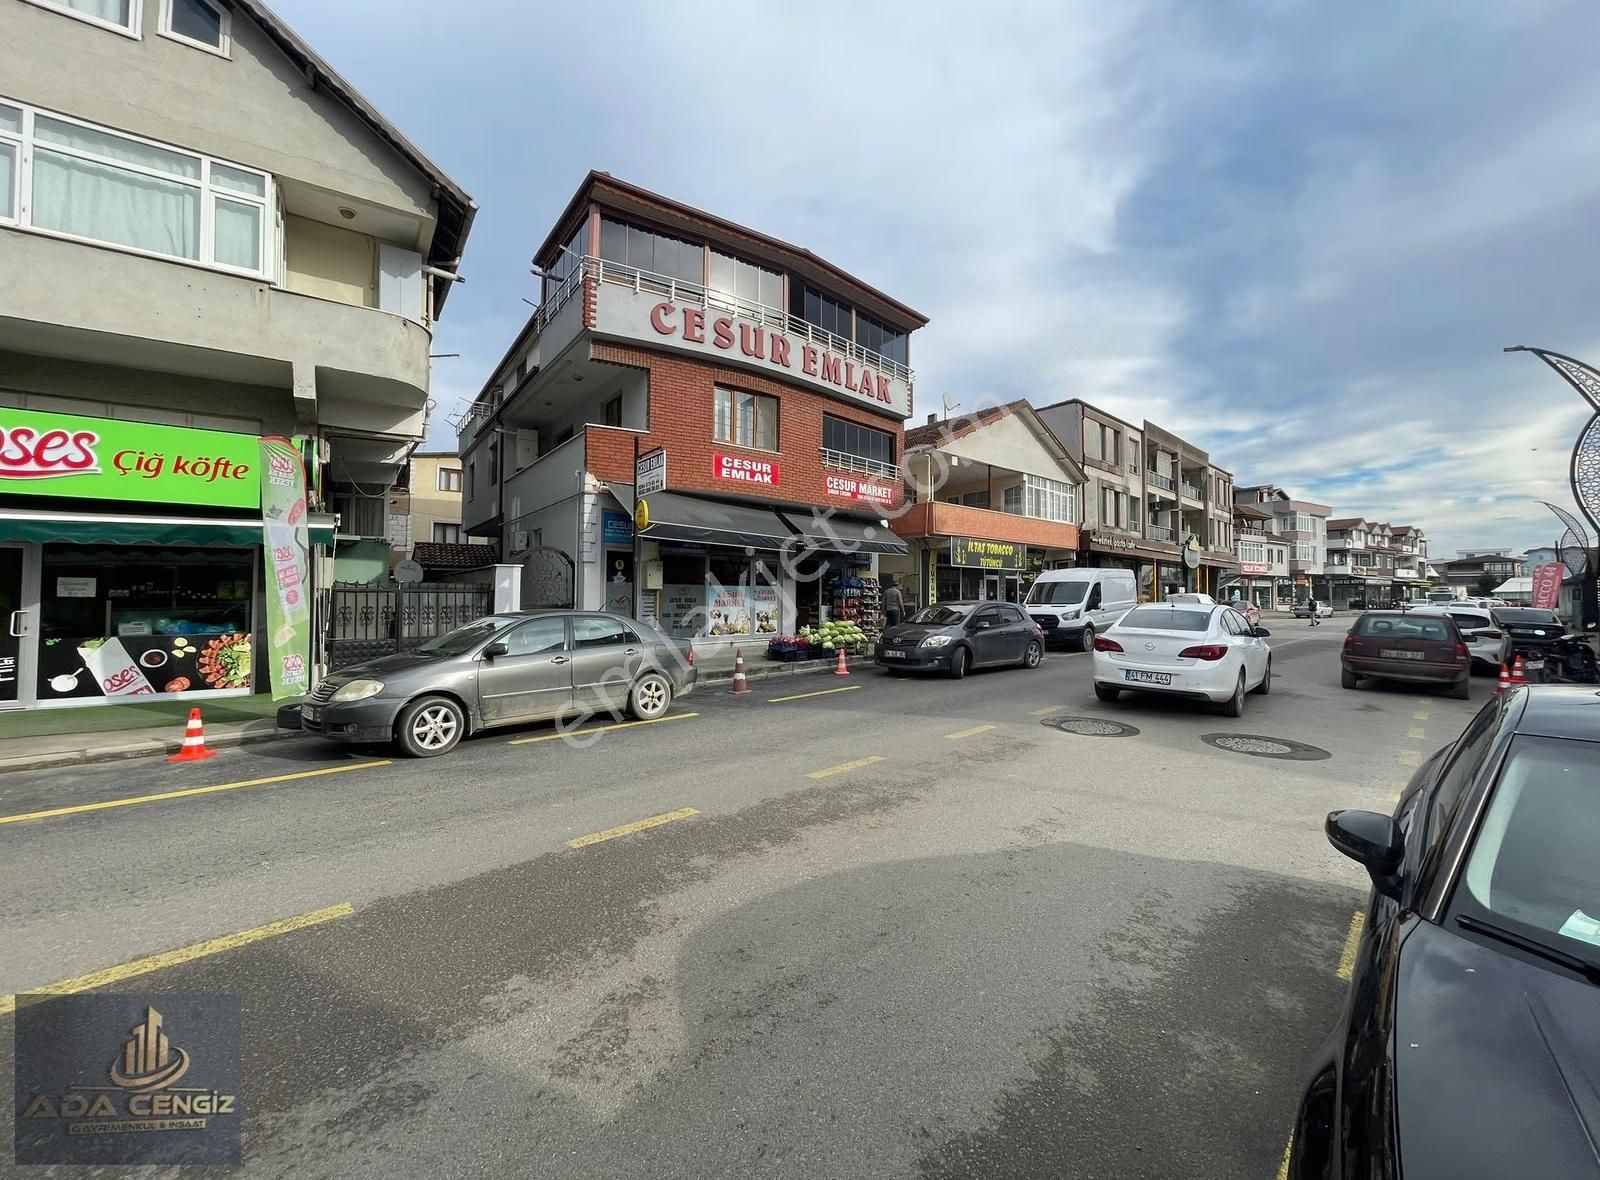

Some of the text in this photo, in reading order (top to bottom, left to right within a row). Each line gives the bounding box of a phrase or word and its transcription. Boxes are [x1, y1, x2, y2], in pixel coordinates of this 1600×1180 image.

[650, 302, 892, 404] CESUR EMLAK
[113, 450, 165, 479] Çiğ
[172, 455, 249, 483] köfte
[638, 458, 651, 475] CESUR
[721, 456, 772, 473] CESUR
[721, 467, 772, 484] EMLAK
[826, 476, 857, 492] CESUR
[858, 482, 892, 499] MARKET
[986, 543, 1013, 556] TOBACCO
[103, 665, 139, 692] oses
[1131, 671, 1138, 679] 41
